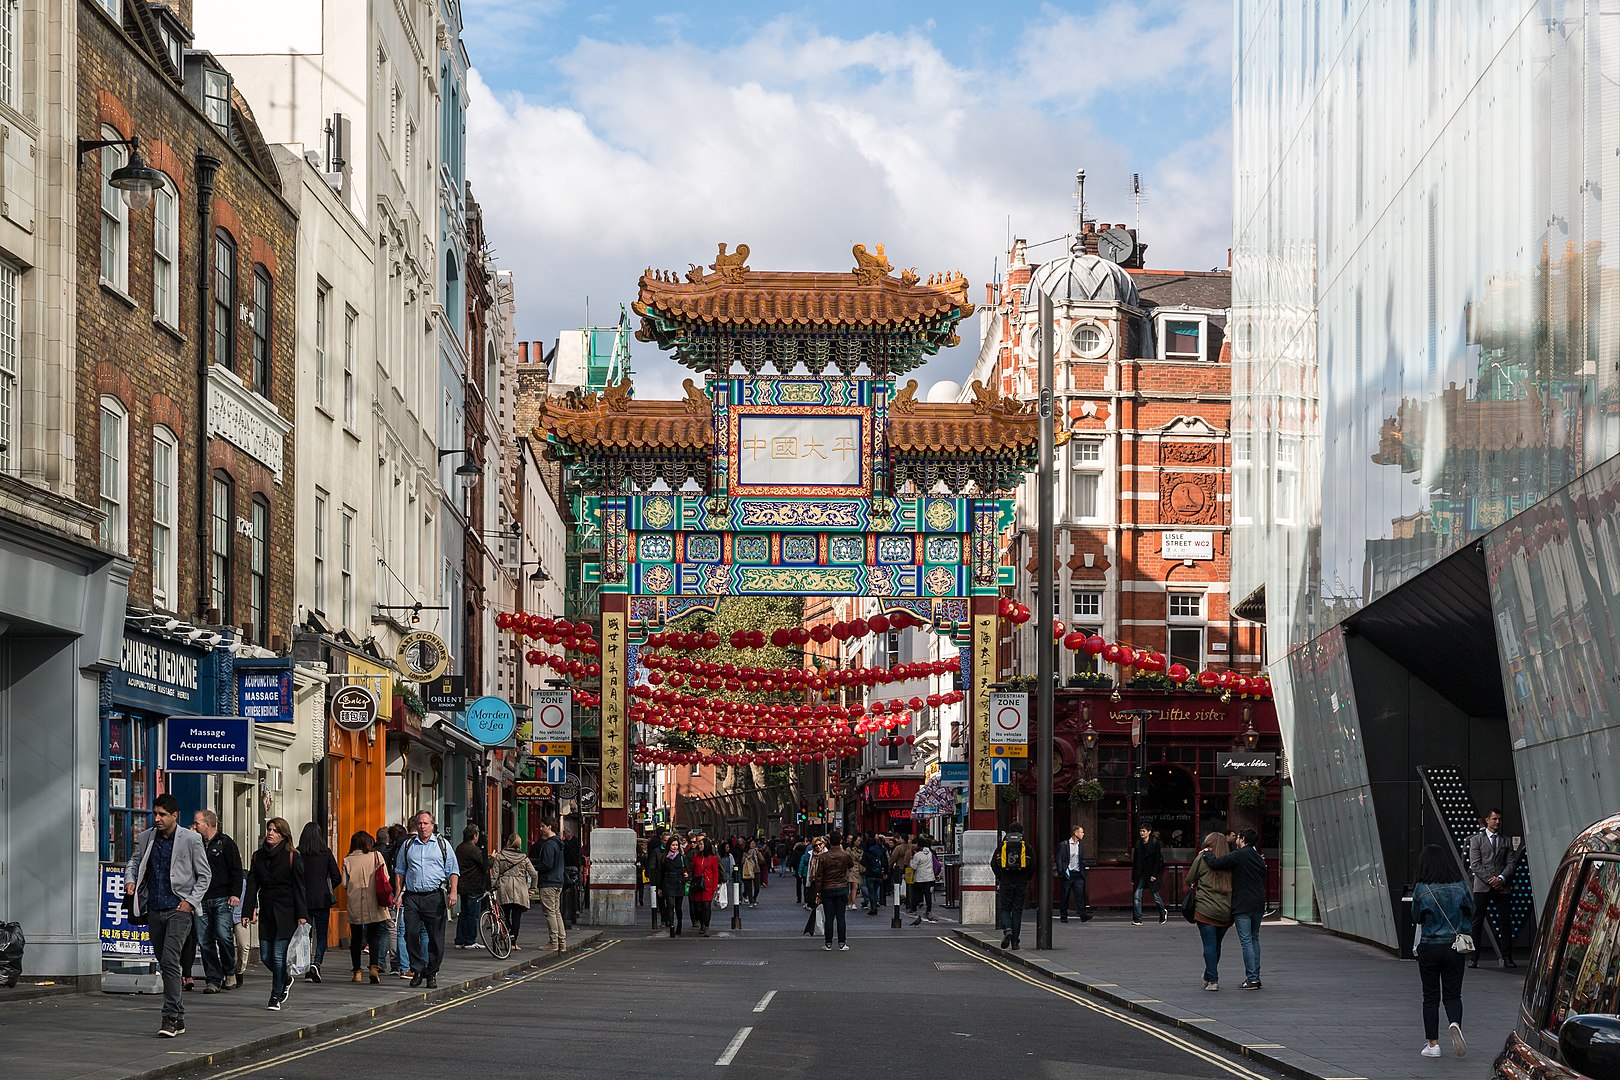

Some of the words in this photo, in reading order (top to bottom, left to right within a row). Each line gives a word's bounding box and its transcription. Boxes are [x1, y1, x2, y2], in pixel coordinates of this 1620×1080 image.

[214, 390, 261, 438] EXCHANGE
[743, 433, 857, 462] 中國太平
[399, 636, 413, 655] WAXY
[416, 633, 446, 660] O'CONNOR'S
[120, 637, 158, 680] CHINESE
[159, 648, 197, 690] MEDICINE
[244, 675, 279, 688] ACUPUNCTURE
[408, 672, 432, 681] LONDON
[127, 677, 156, 692] ACUPUNCTURE
[157, 685, 175, 697] MASSAGE
[176, 689, 190, 701] HERBS
[244, 691, 279, 701] MASSAGE
[244, 705, 261, 717] CHINESE
[261, 705, 279, 717] MEDICINE
[470, 708, 510, 720] Morden
[1194, 709, 1226, 721] sister
[479, 720, 488, 730] &
[487, 719, 504, 732] Lea
[190, 728, 226, 738] Massage
[180, 741, 236, 751] Acupuncture
[170, 754, 204, 762] Chinese
[206, 754, 245, 763] Medicine
[105, 866, 125, 874] MOBILE
